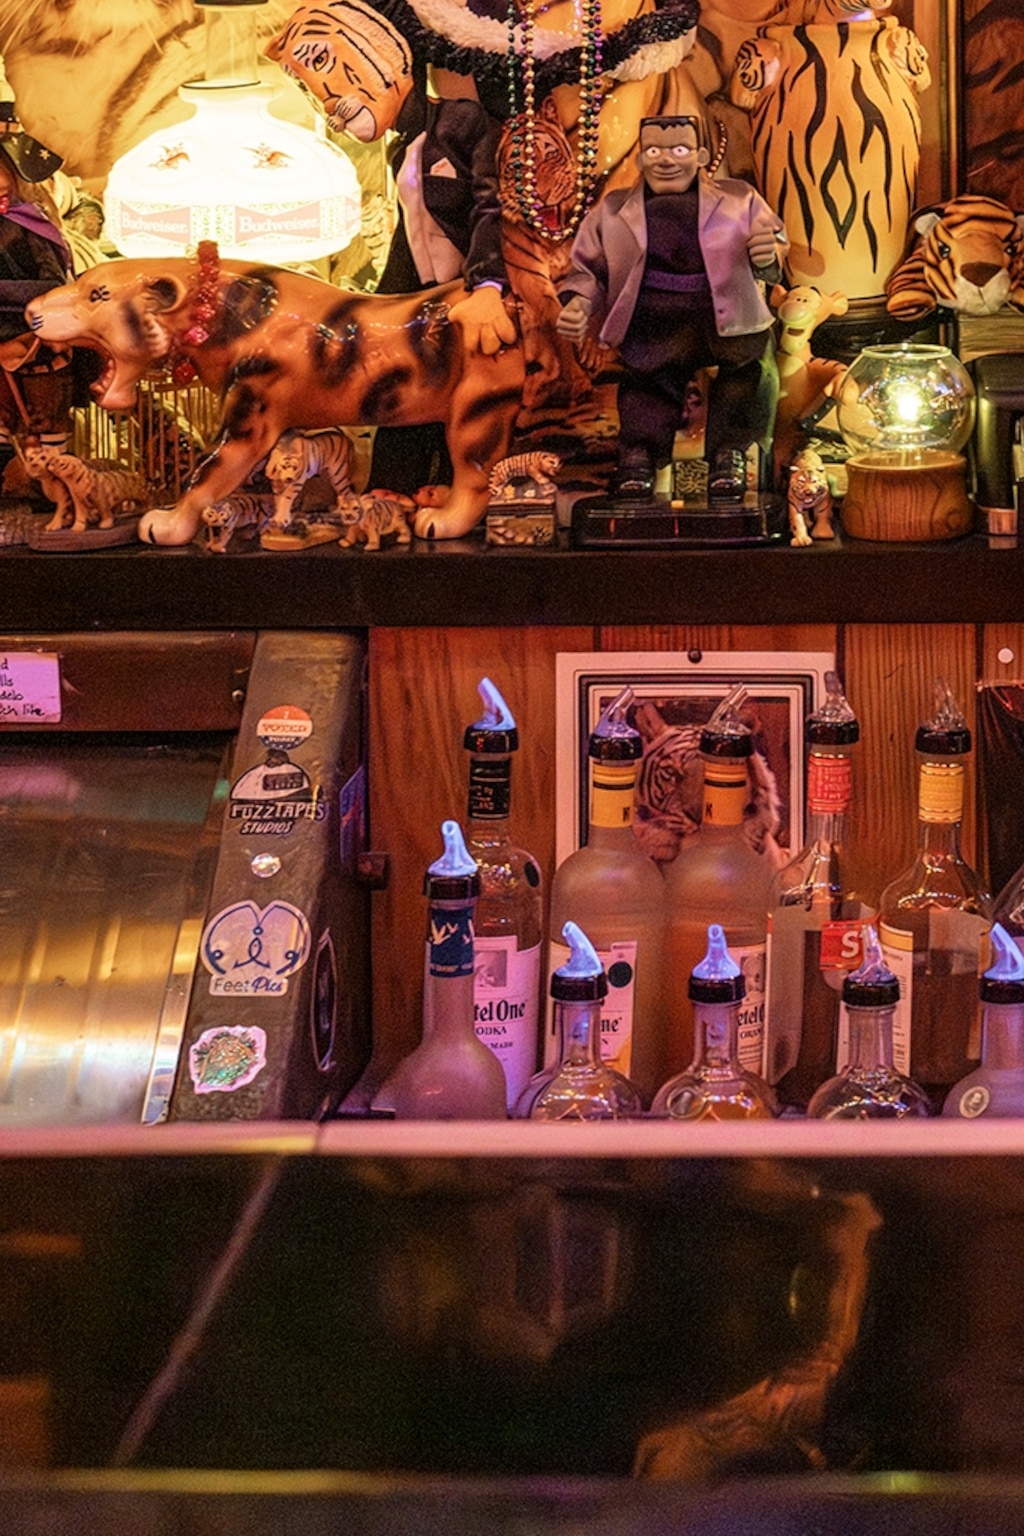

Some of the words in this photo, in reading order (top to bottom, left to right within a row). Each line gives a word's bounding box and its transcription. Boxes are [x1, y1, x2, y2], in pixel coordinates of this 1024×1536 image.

[121, 214, 189, 234] Budweiser
[239, 216, 318, 233] Budweiser
[262, 723, 308, 733] VOTED
[240, 821, 293, 835] STUDIOS
[213, 977, 250, 993] Feet
[251, 976, 284, 994] Pics
[496, 999, 527, 1022] One
[475, 1026, 508, 1037] ODKA
